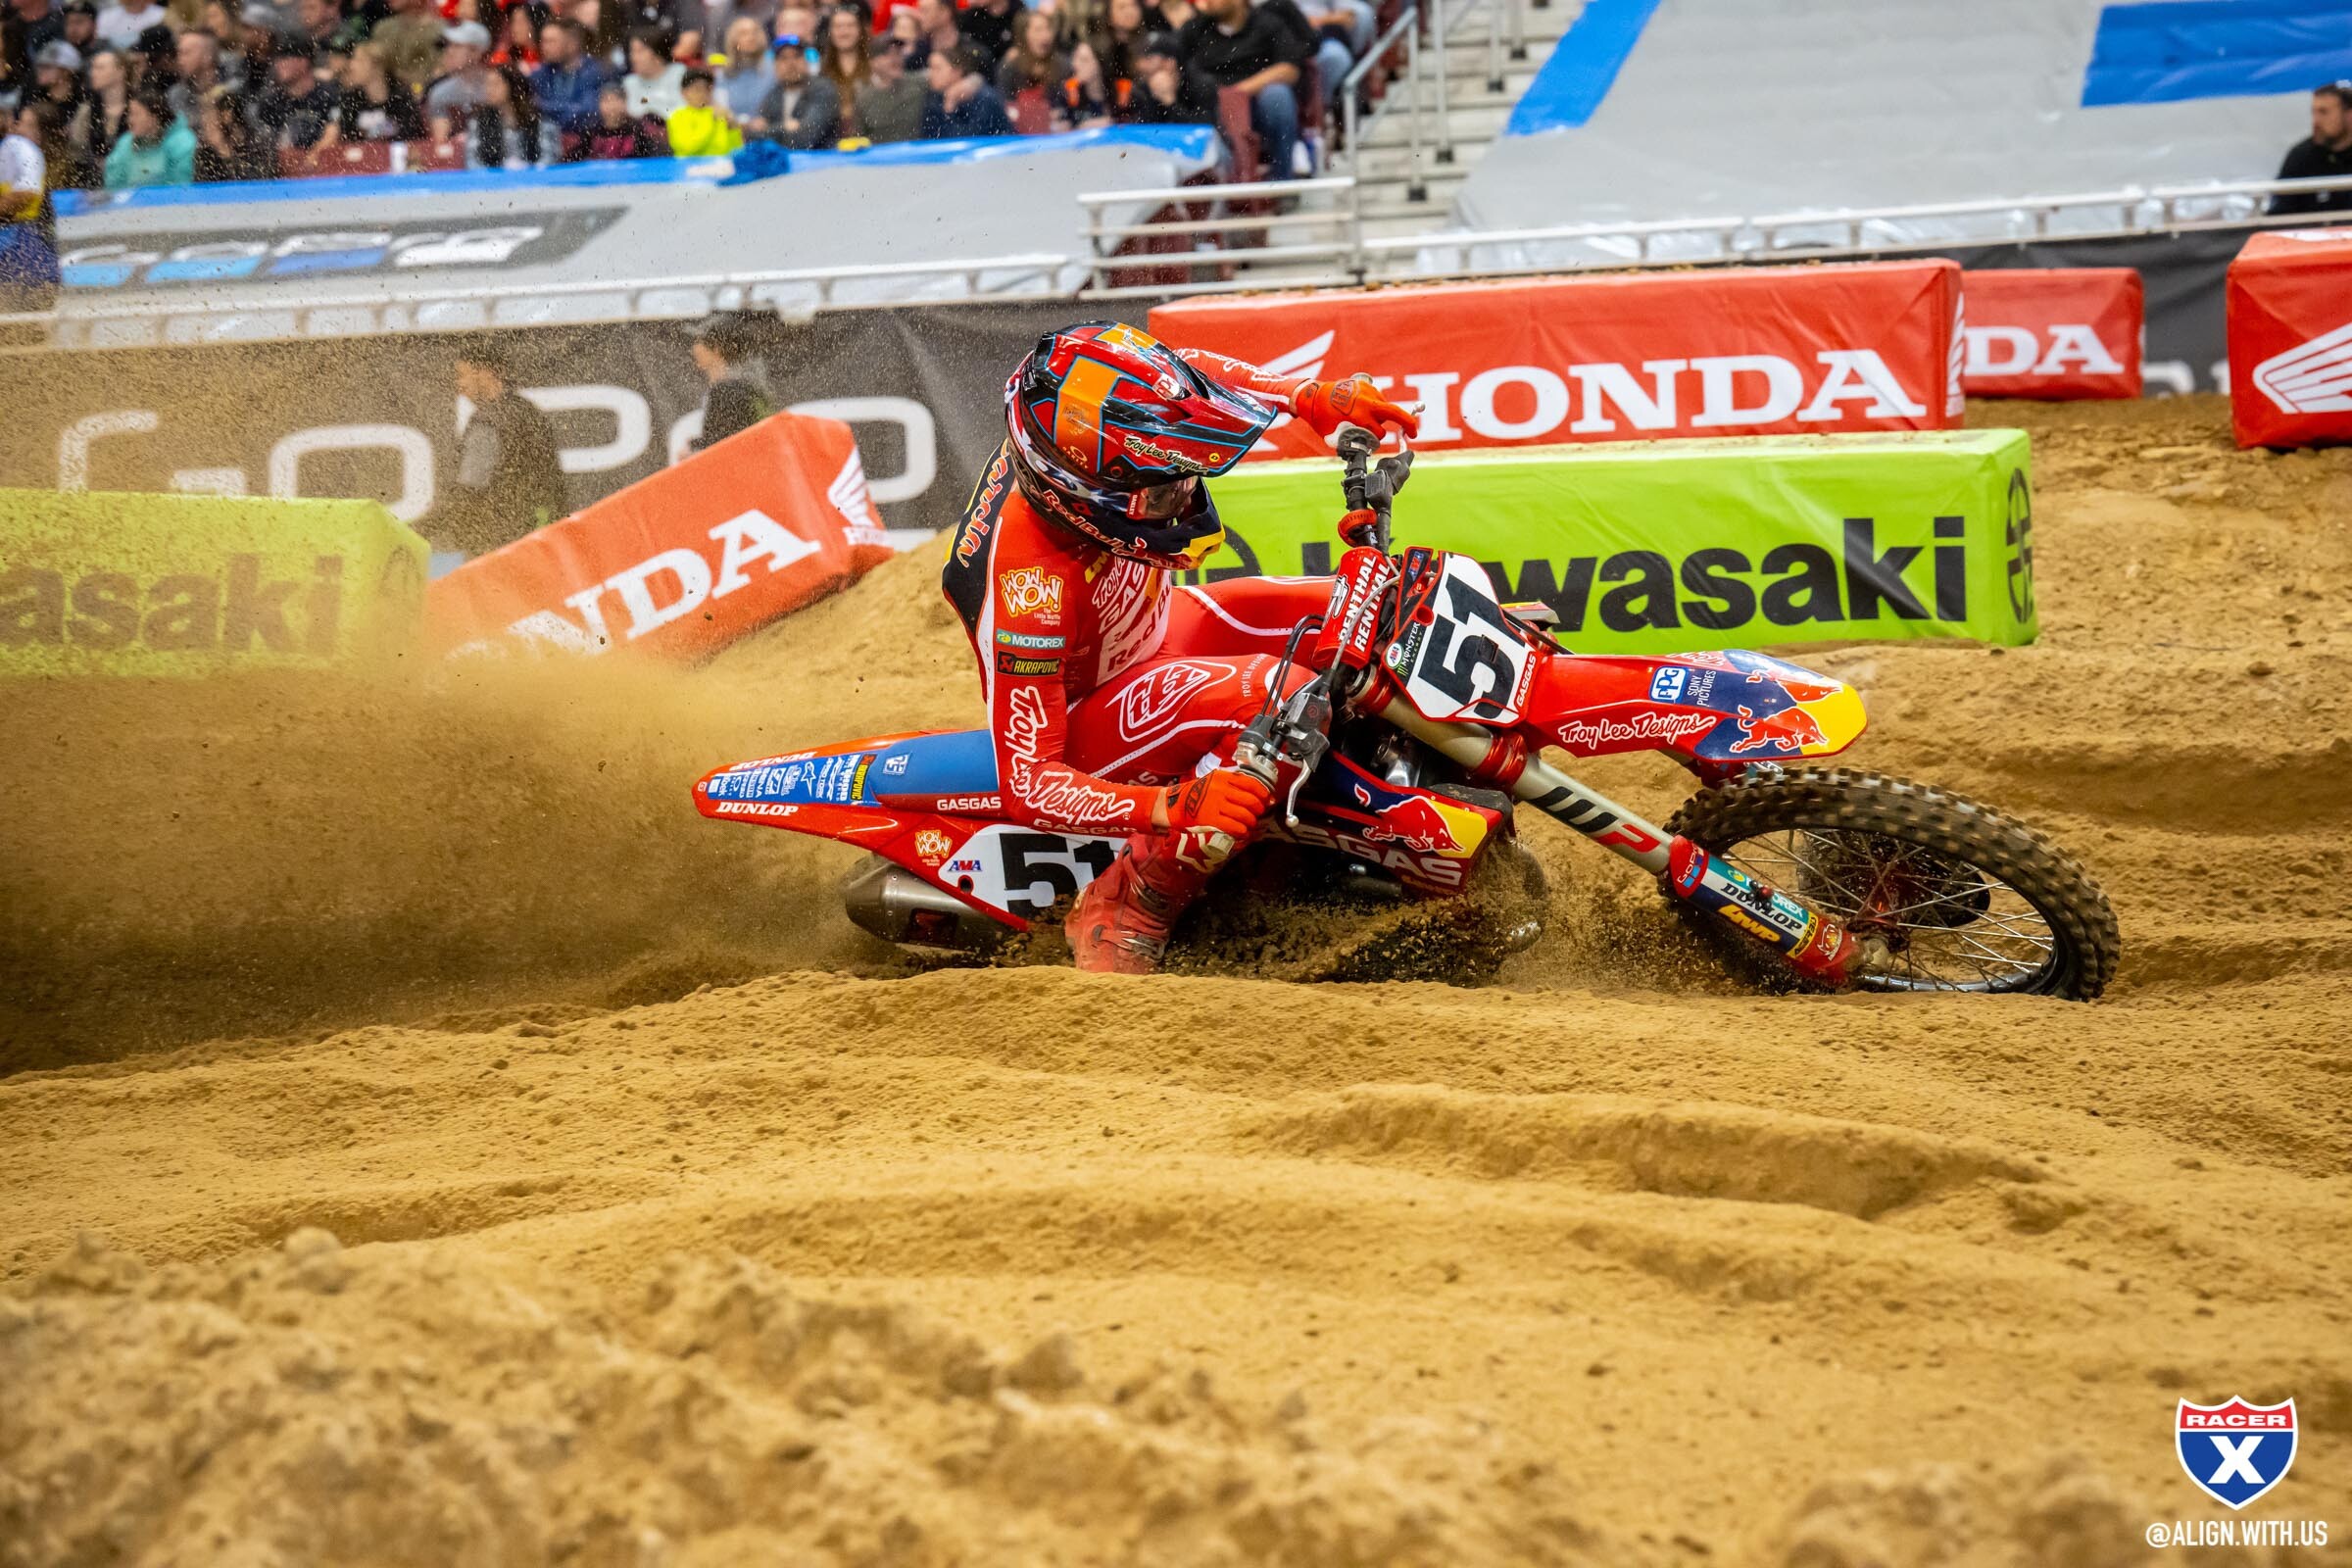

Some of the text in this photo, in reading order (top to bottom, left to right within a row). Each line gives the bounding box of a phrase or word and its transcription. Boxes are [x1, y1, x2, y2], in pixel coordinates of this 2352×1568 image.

[1372, 349, 1927, 443] HONDA
[956, 438, 1009, 568] arcia
[445, 509, 821, 661] NDA
[1301, 515, 1966, 632] wasaki
[1338, 555, 1376, 644] RENTHAL
[1354, 564, 1391, 654] RENTHAL
[1012, 635, 1064, 648] MOTOREX
[1108, 612, 1155, 672] Red
[1402, 621, 1420, 666] MONSTER
[1418, 573, 1526, 719] 51
[1516, 654, 1536, 707] GASGAS
[1657, 668, 1680, 699] PPG
[1687, 675, 1702, 697] SONY
[1696, 670, 1716, 707] PICTURES
[1558, 711, 1717, 750] Troy Lee Designs
[715, 802, 799, 816] DUNLOP
[936, 797, 1002, 810] GASGAS
[1026, 770, 1135, 825] Designs
[948, 859, 982, 872] AMA
[999, 833, 1117, 919] 51
[1721, 883, 1803, 932] DUNLOP
